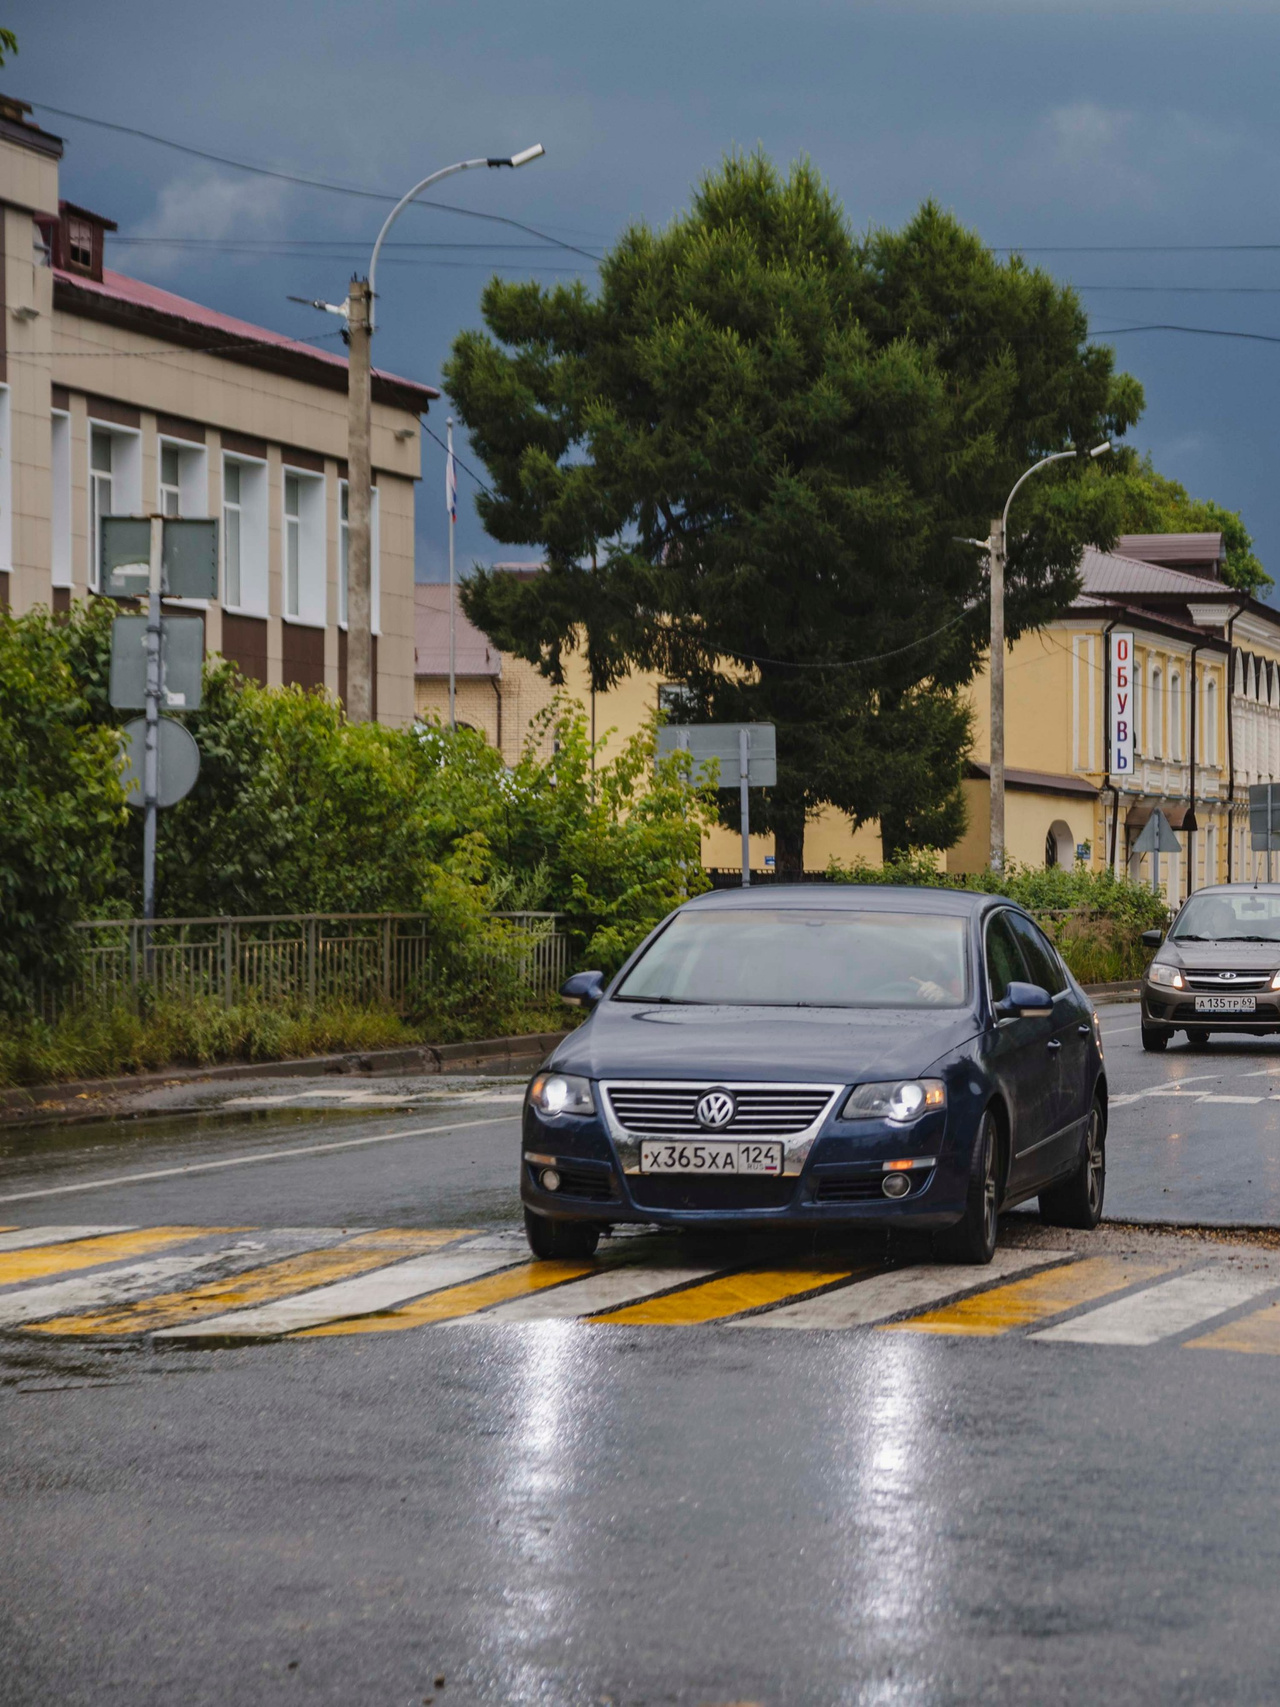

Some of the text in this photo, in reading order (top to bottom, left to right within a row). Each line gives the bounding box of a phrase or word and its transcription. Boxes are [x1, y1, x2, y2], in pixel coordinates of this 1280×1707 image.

[1116, 639, 1128, 769] ОБУВЬ
[1241, 998, 1252, 1006] 69
[649, 1146, 775, 1170] Х365ХА 124
